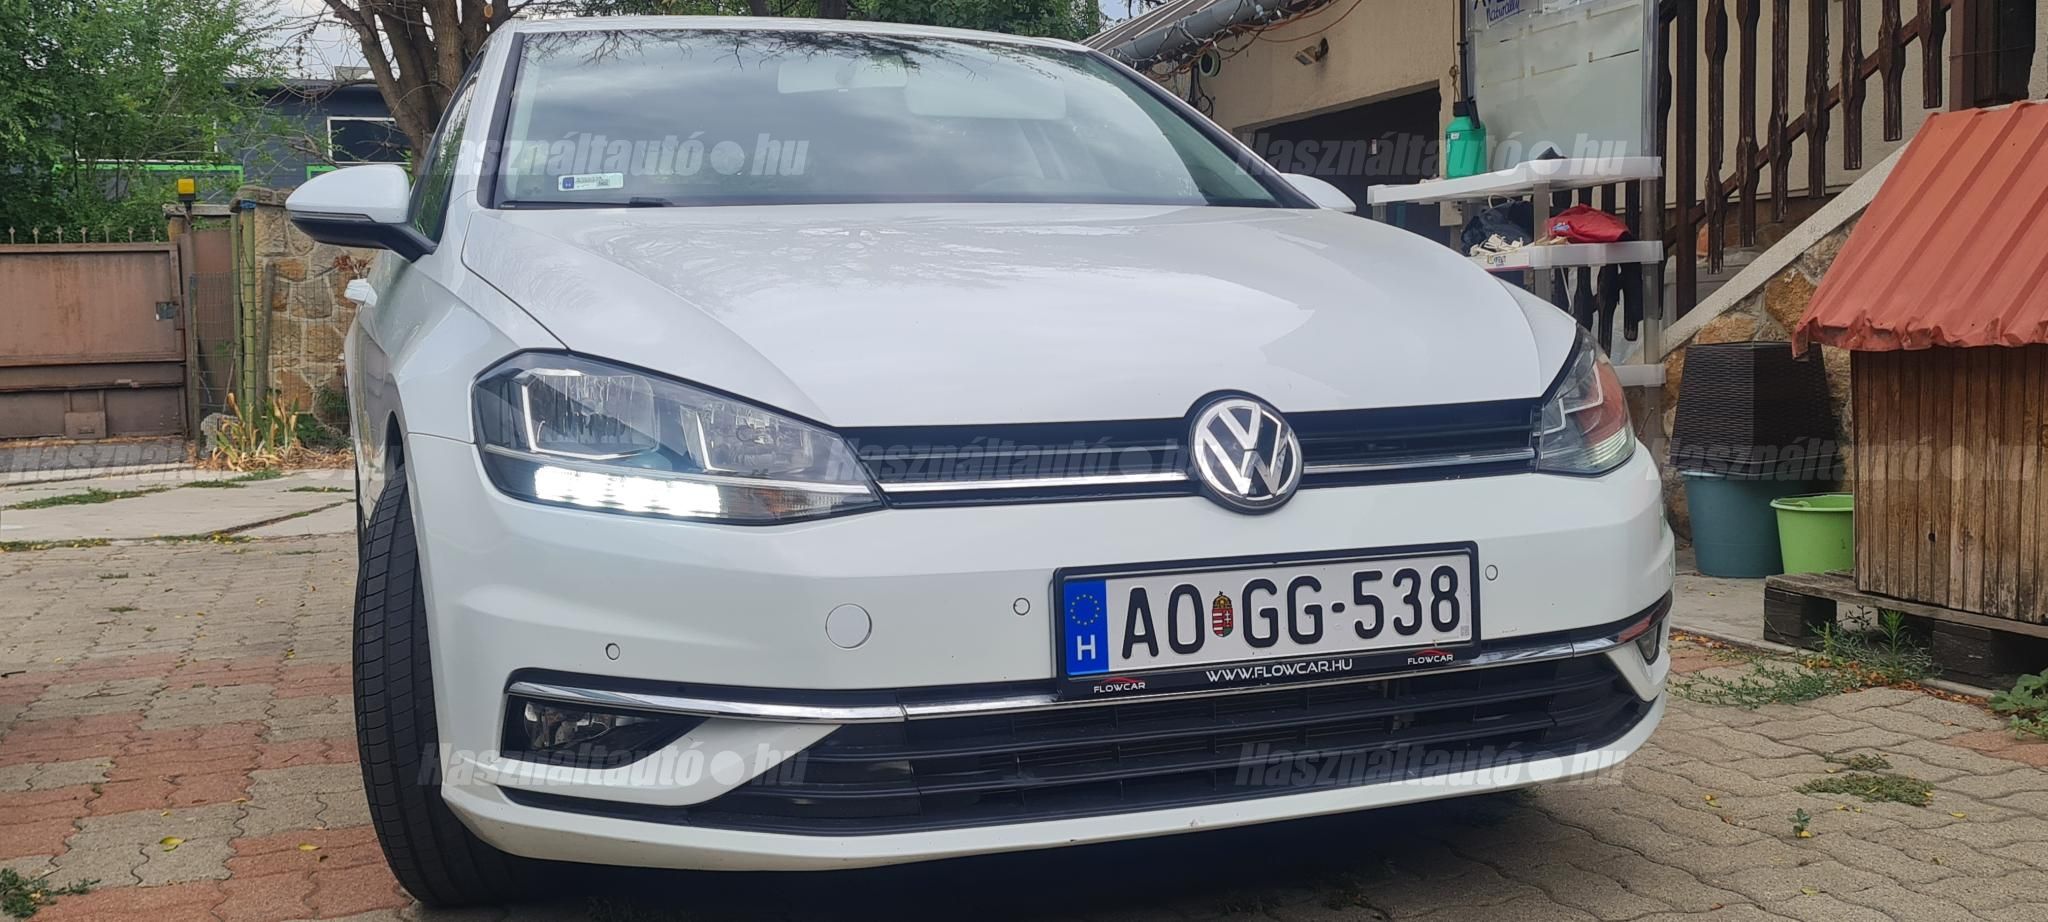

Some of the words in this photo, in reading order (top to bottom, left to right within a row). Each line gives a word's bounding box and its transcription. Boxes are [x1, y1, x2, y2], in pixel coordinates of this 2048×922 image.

[1122, 584, 1206, 660] AO
[1241, 564, 1461, 649] GG-538
[1076, 633, 1097, 661] H
[1407, 653, 1455, 666] FLOWCAR
[1205, 658, 1353, 683] WWW.FLOWCAR.HU
[1093, 681, 1147, 694] FLOWCAR
